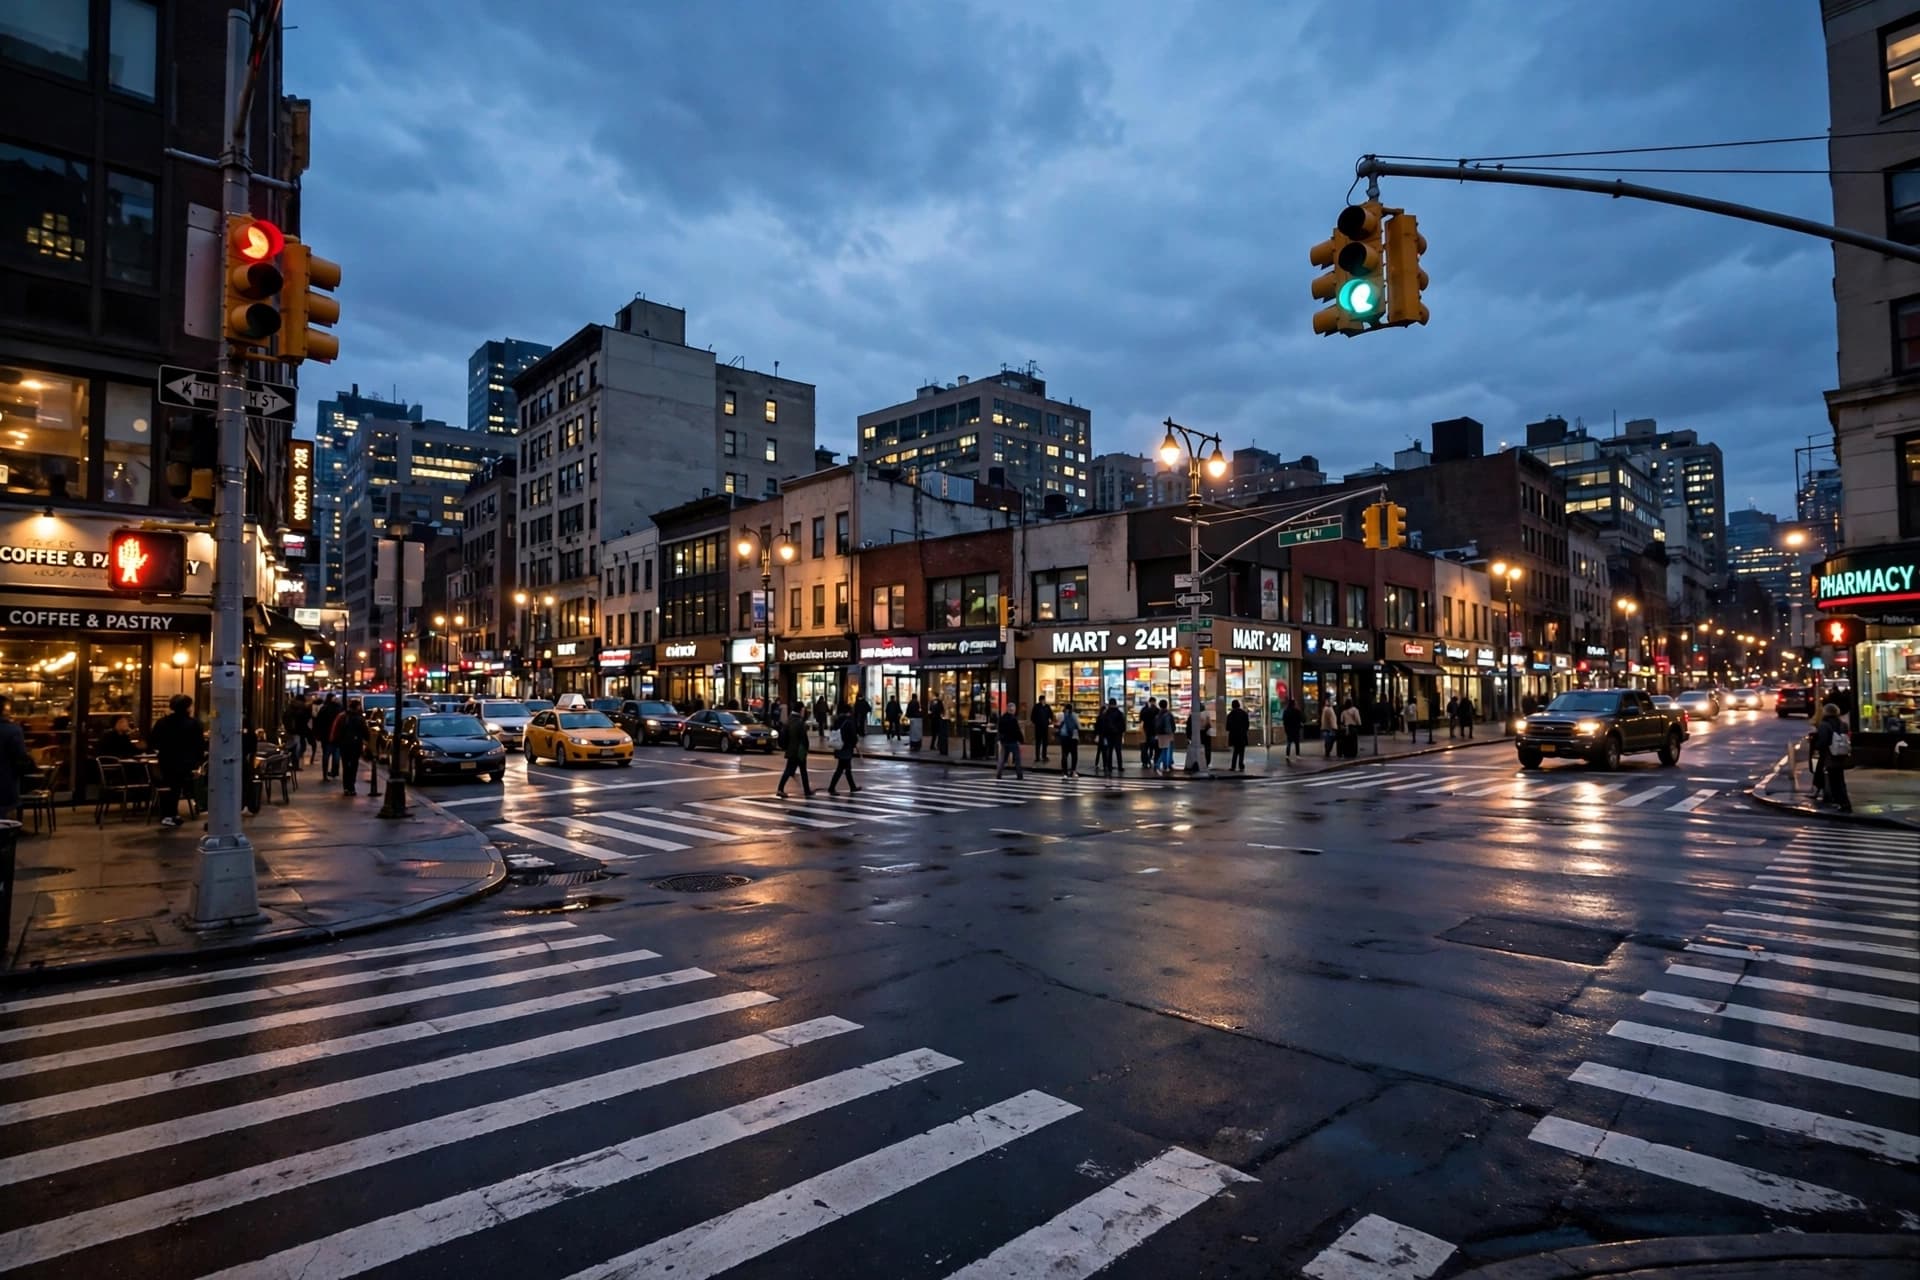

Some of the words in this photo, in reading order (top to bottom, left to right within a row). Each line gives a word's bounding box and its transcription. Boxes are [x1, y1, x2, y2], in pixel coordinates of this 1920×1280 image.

[261, 395, 278, 409] ST
[0, 546, 68, 566] COFFEE
[72, 551, 87, 567] &
[1820, 565, 1914, 599] PHARMACY
[9, 610, 80, 627] COFFEE
[86, 613, 99, 628] &
[106, 615, 173, 631] PASTRY
[1052, 630, 1110, 653] MART
[1135, 627, 1177, 650] 24H
[1233, 628, 1265, 651] MART
[1272, 631, 1292, 652] 24H
